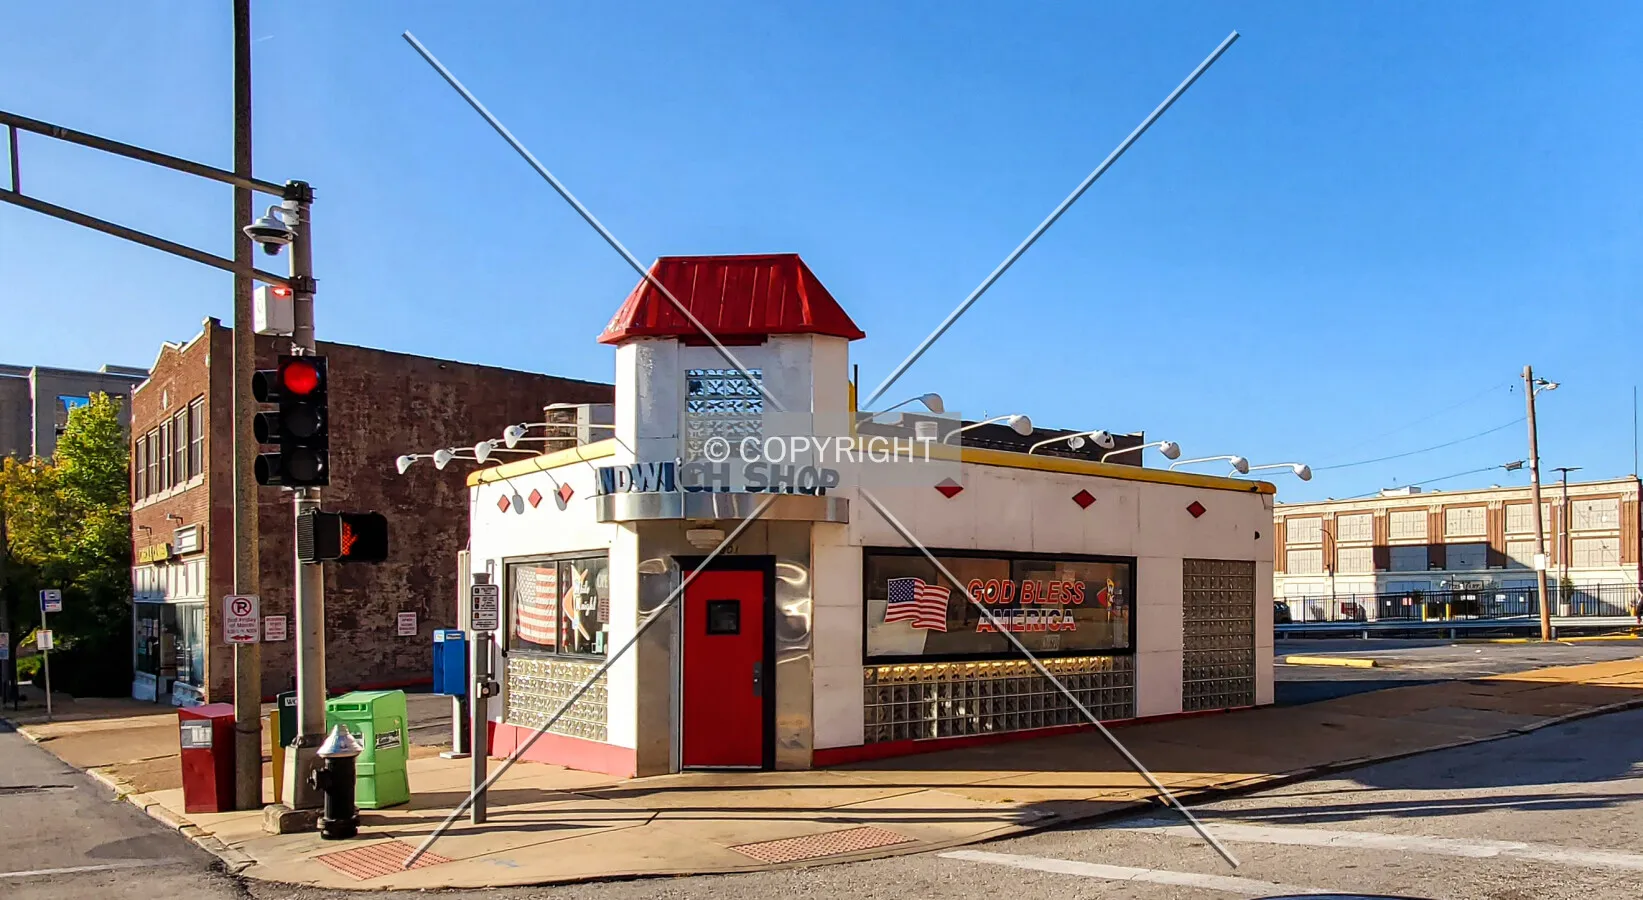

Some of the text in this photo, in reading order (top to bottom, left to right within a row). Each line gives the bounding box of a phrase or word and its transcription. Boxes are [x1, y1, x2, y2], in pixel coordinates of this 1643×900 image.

[743, 462, 840, 496] SHOP
[967, 579, 1085, 604] GOD BLESS
[976, 609, 1076, 633] AMERICA
